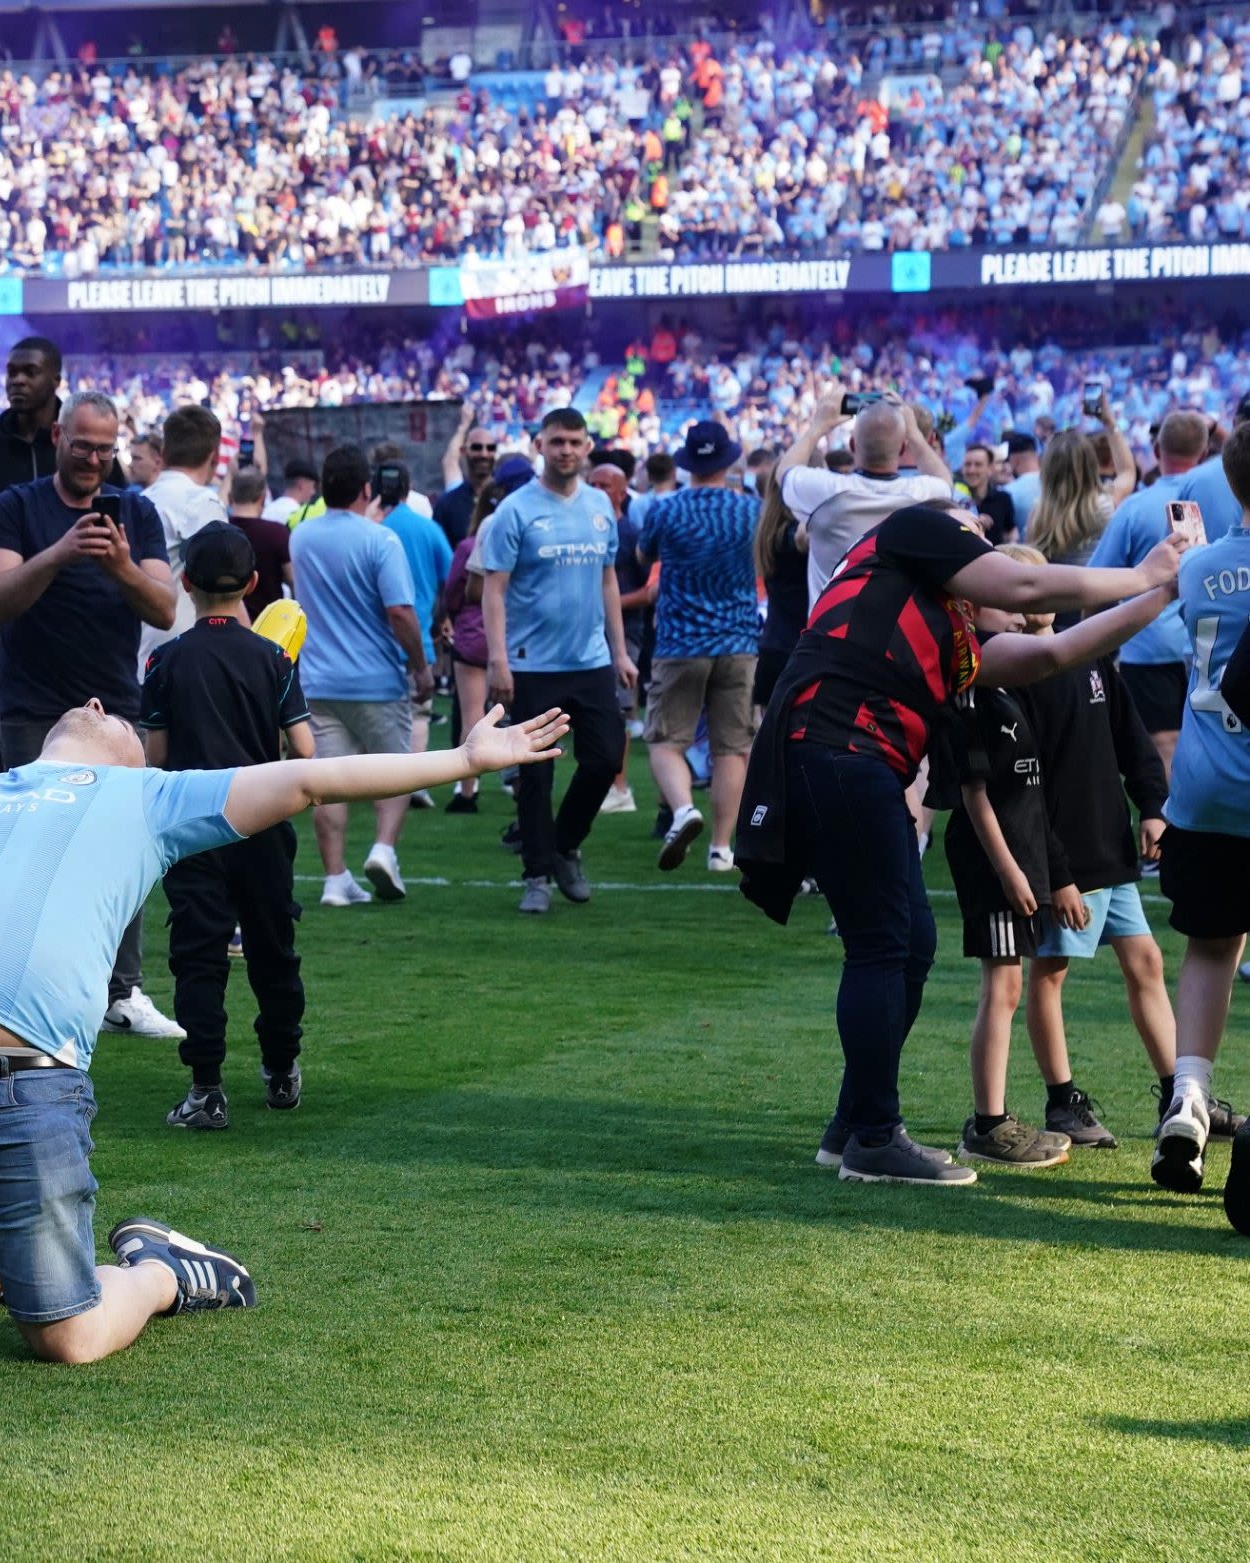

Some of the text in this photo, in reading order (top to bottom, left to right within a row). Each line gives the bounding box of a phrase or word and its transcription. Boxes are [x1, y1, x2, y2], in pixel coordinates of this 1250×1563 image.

[587, 266, 634, 297] EAVE
[635, 265, 669, 296] THE
[669, 263, 724, 294] PITCH
[725, 260, 850, 293] IMMEDIATELY
[981, 252, 1052, 285] PLEASE
[1052, 249, 1112, 282] LEAVE
[1112, 247, 1150, 280] THE
[1150, 245, 1210, 278] PITCH
[68, 274, 390, 309] PLEASE LEAVE THE PITCH IMMEDIATELY
[538, 542, 607, 558] ETIHAD
